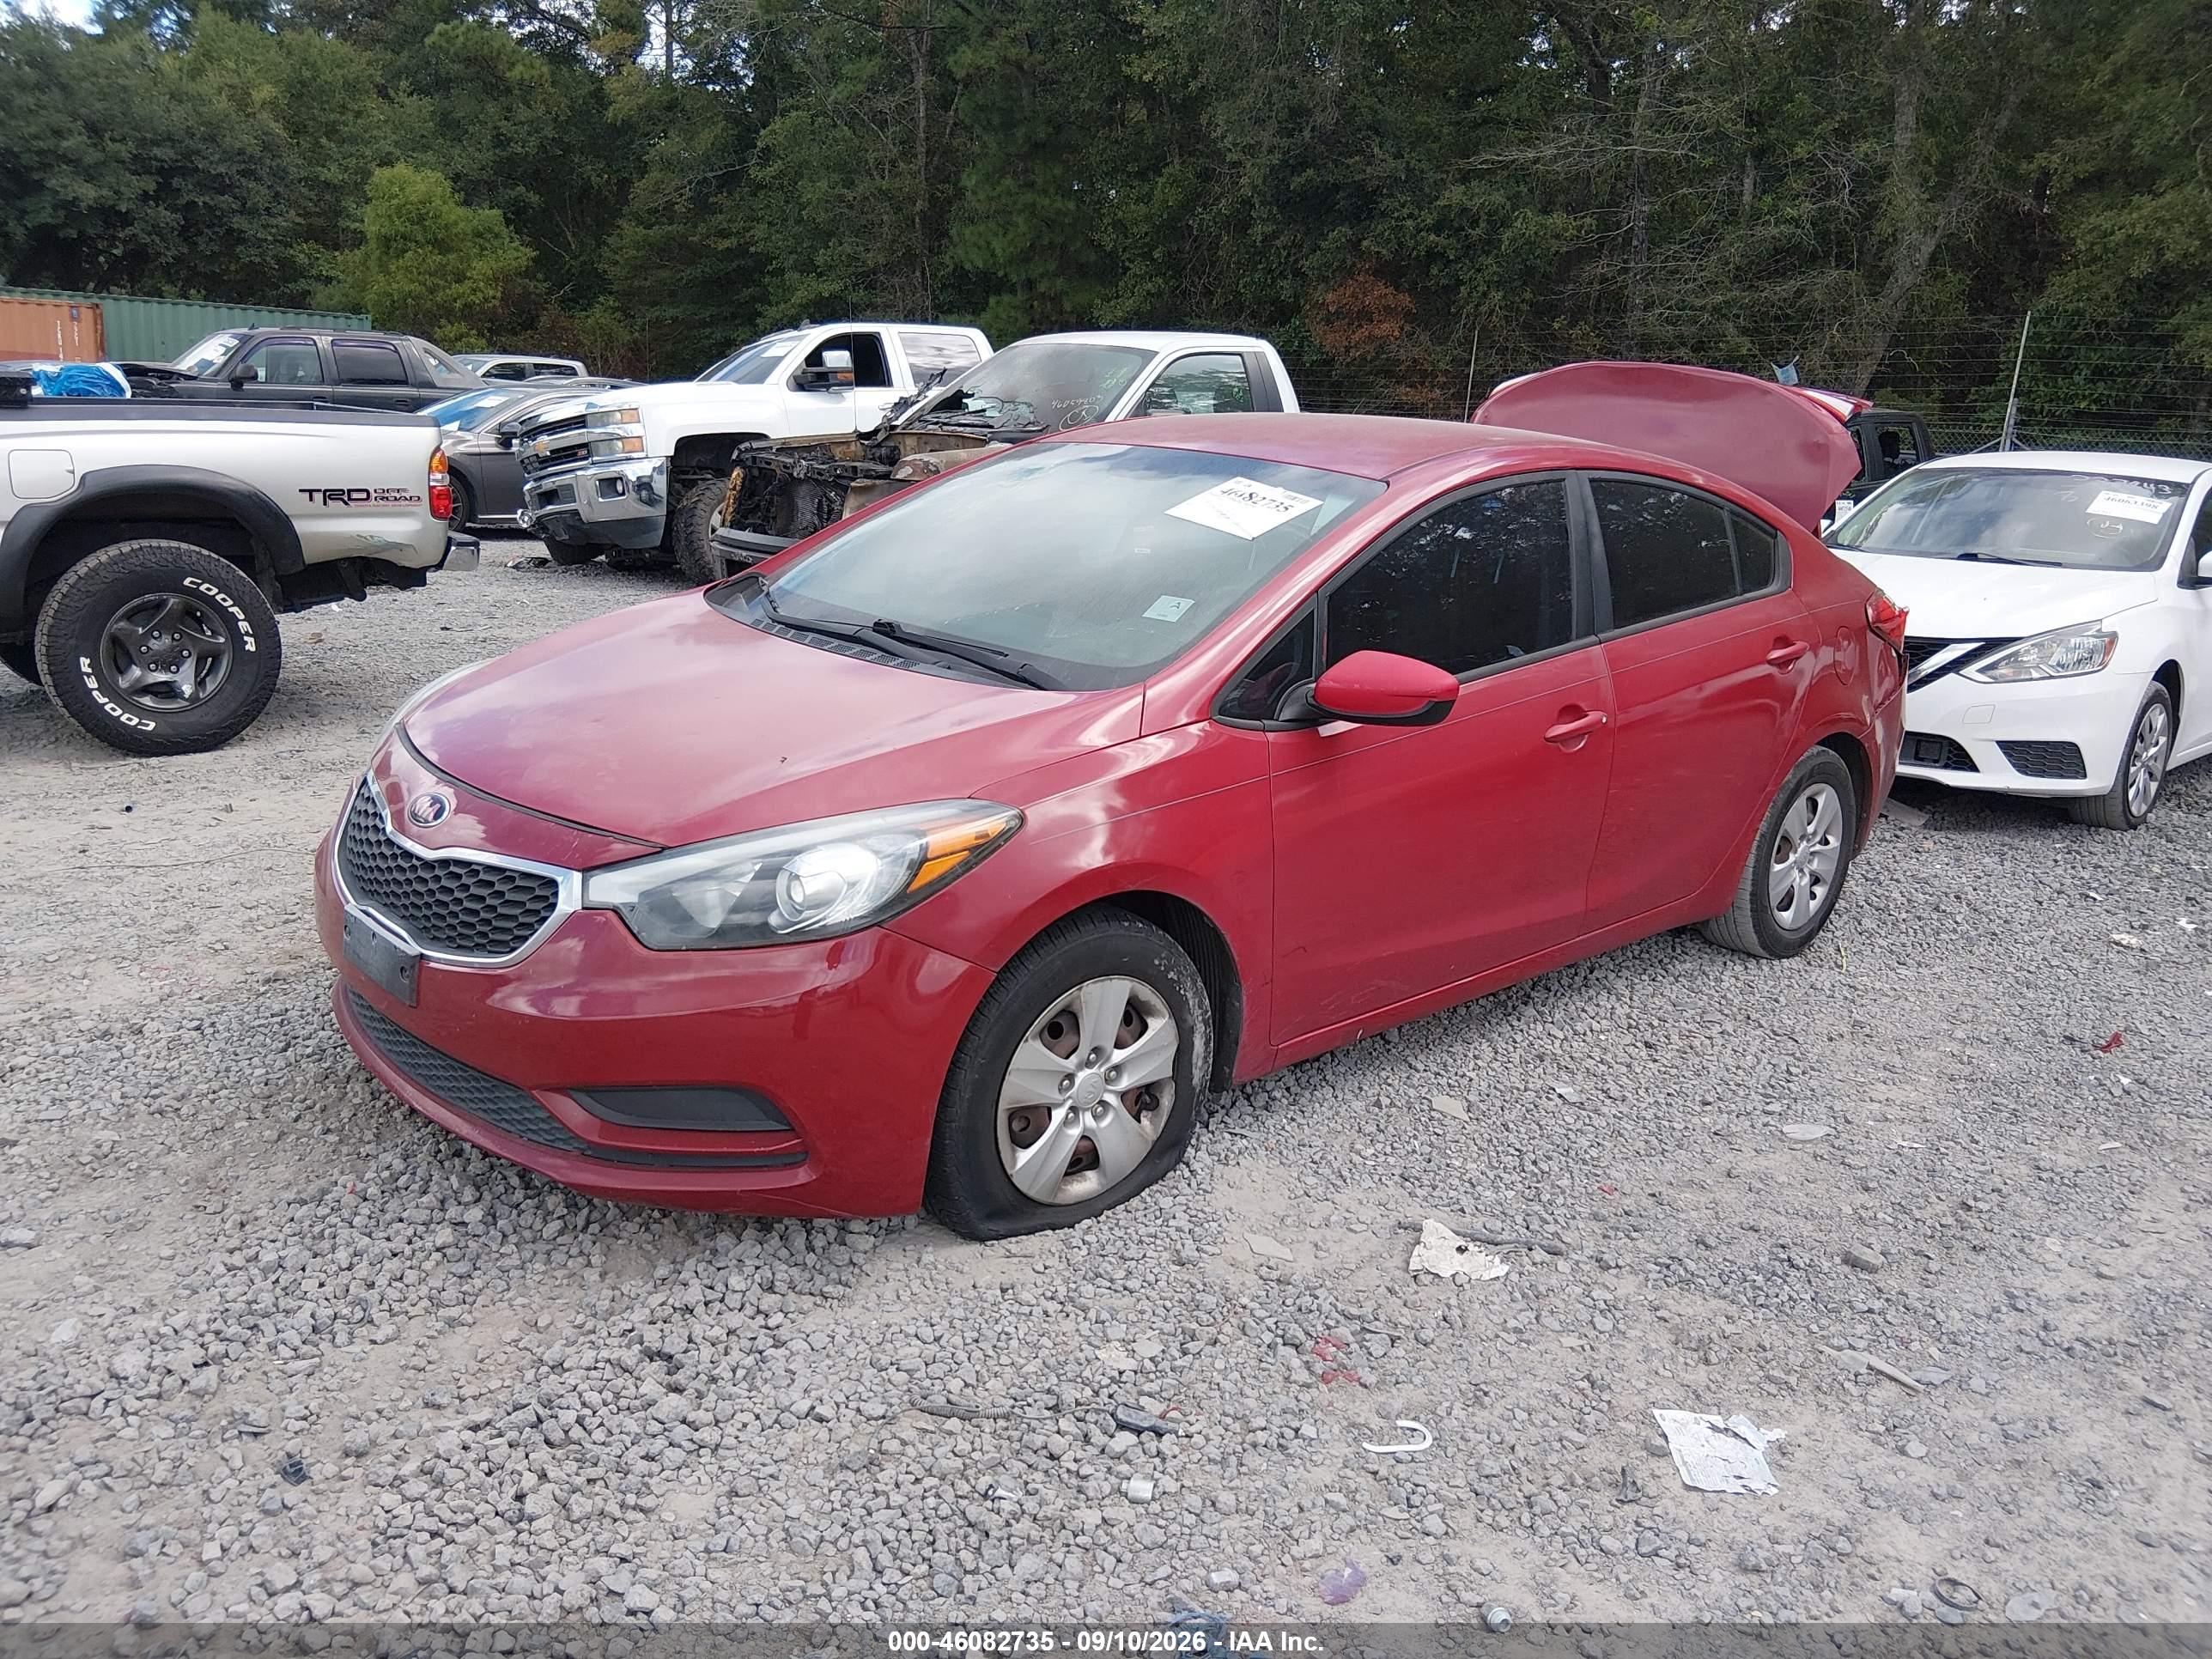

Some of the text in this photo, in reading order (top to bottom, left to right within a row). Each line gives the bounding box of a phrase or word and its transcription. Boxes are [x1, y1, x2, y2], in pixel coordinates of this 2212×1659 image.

[299, 488, 371, 507] TRD
[183, 577, 257, 653] COOPER
[79, 656, 156, 732] COOPER
